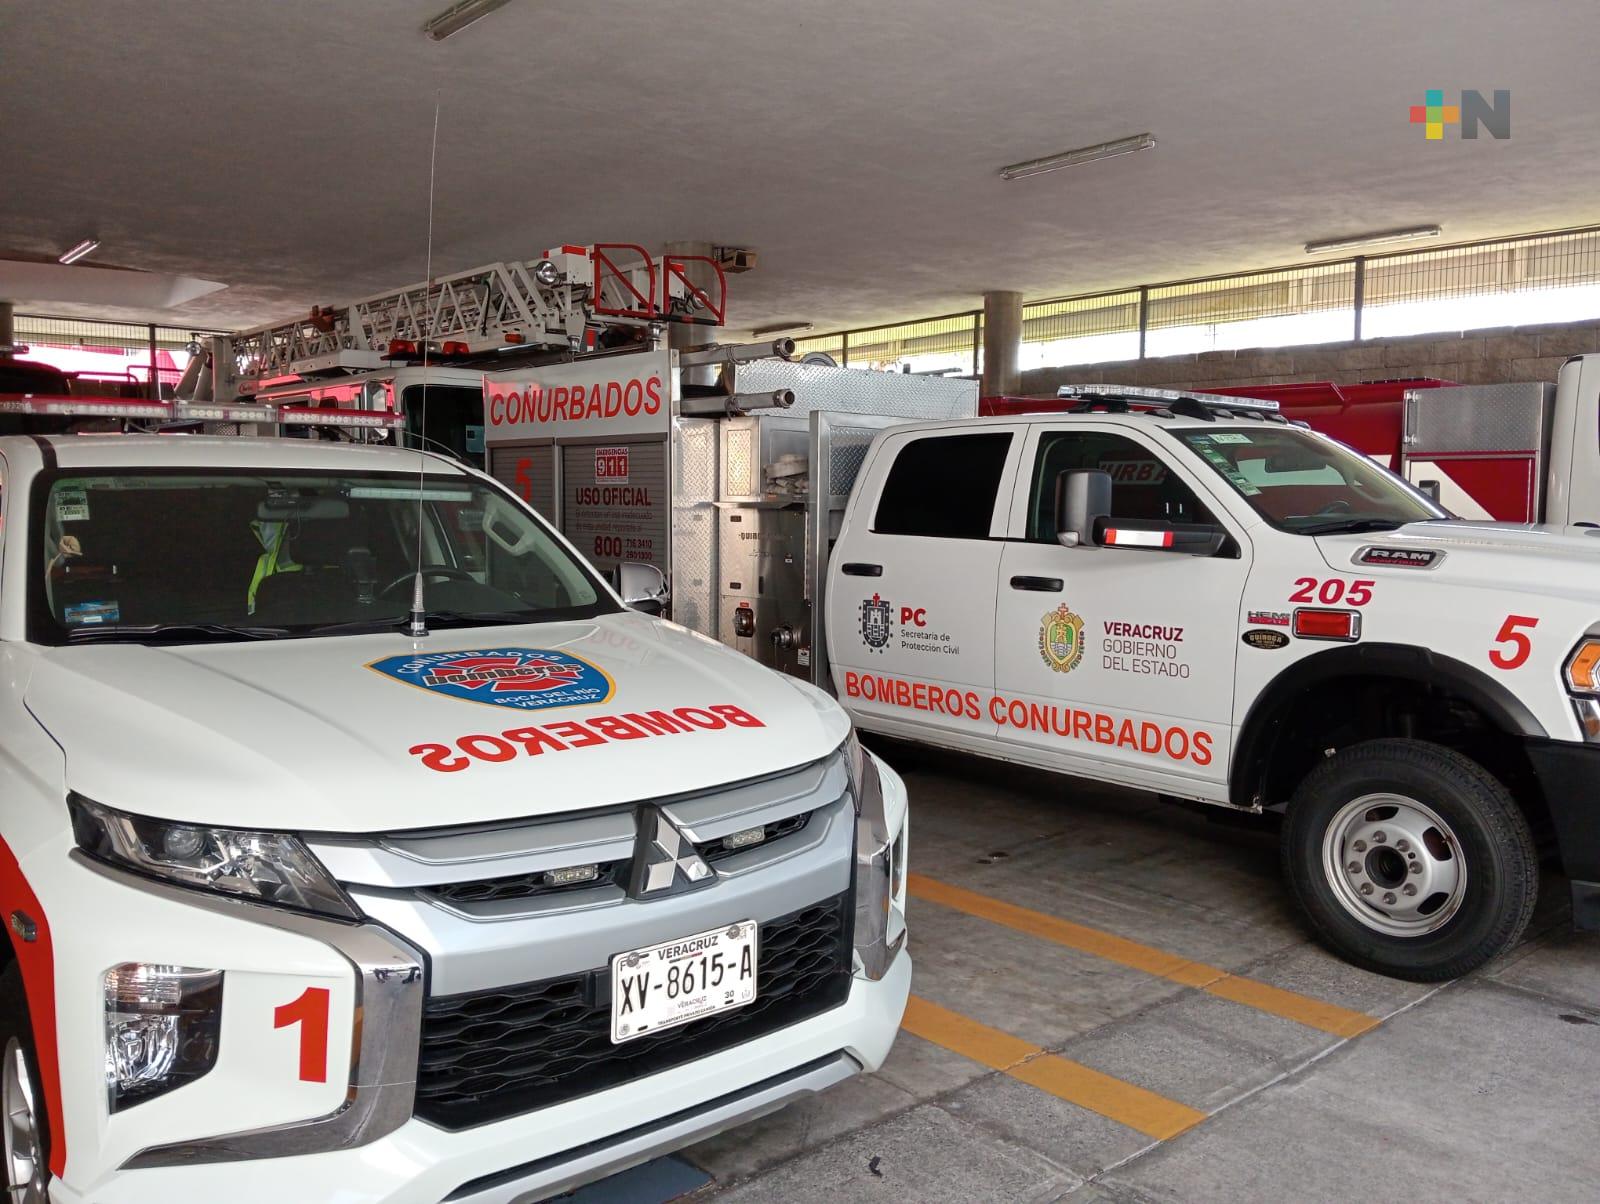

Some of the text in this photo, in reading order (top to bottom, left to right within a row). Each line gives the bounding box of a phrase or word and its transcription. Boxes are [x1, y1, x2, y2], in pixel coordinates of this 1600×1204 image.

[490, 376, 661, 426] CONURBADOS
[597, 458, 626, 475] 911
[514, 457, 533, 503] 5
[576, 487, 652, 506] USO OFICIAL
[594, 535, 622, 557] 800
[1370, 550, 1431, 561] RAM
[1288, 577, 1375, 606] 205
[900, 607, 927, 627] PC
[940, 633, 951, 642] de
[1103, 621, 1184, 642] VERACRUZ
[1489, 614, 1539, 670] 5
[943, 645, 960, 655] Civil
[1103, 638, 1177, 660] GOBIERNO
[397, 651, 563, 675] CONURBADOS
[1103, 655, 1190, 679] DEL ESTADO
[422, 663, 585, 687] bomberos
[494, 693, 542, 704] BOCA
[542, 690, 574, 699] DEL
[515, 693, 601, 707] VERACRUZ
[845, 671, 1213, 766] BOMBEROS CONURBADOS
[658, 936, 719, 961] VERACRUZ
[620, 944, 752, 1016] XV-8615-A
[724, 990, 735, 999] 30
[274, 987, 330, 1083] 1
